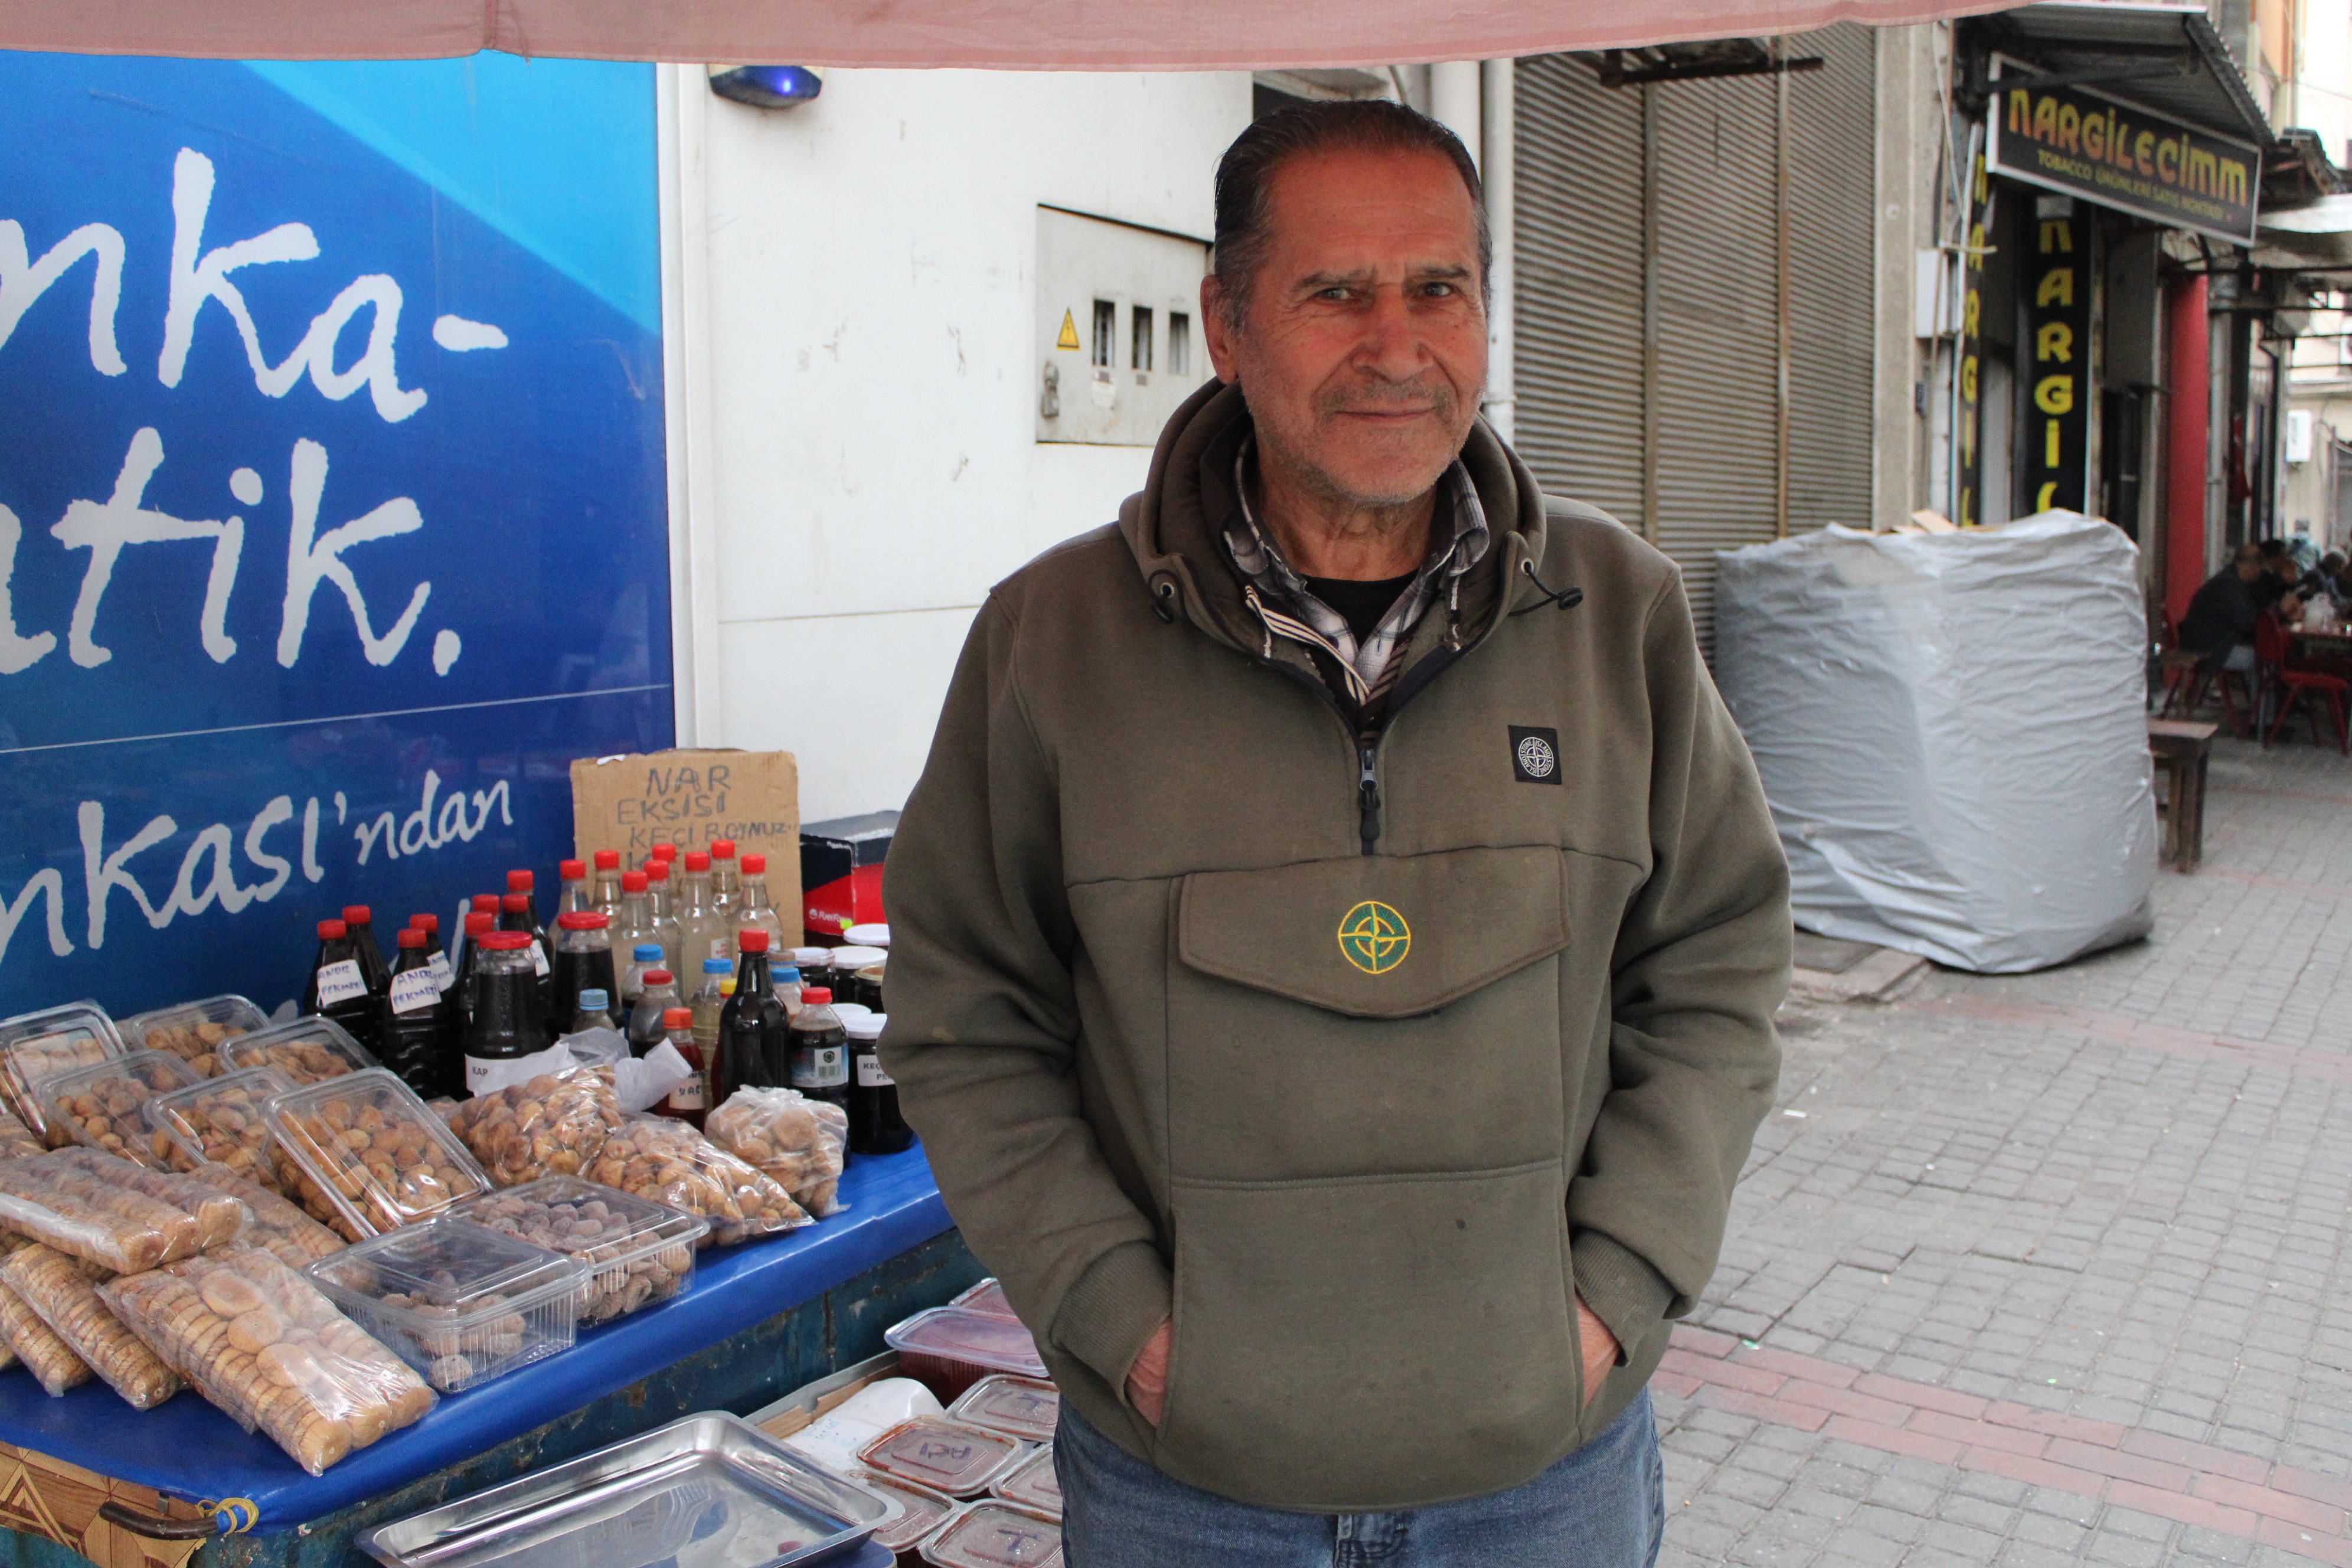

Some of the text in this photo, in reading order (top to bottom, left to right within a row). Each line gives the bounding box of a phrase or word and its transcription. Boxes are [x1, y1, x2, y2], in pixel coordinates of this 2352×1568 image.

[1520, 739, 1551, 757] STONE ISLAND
[1521, 756, 1552, 776] STONE ISLAND
[646, 765, 731, 796] NAR
